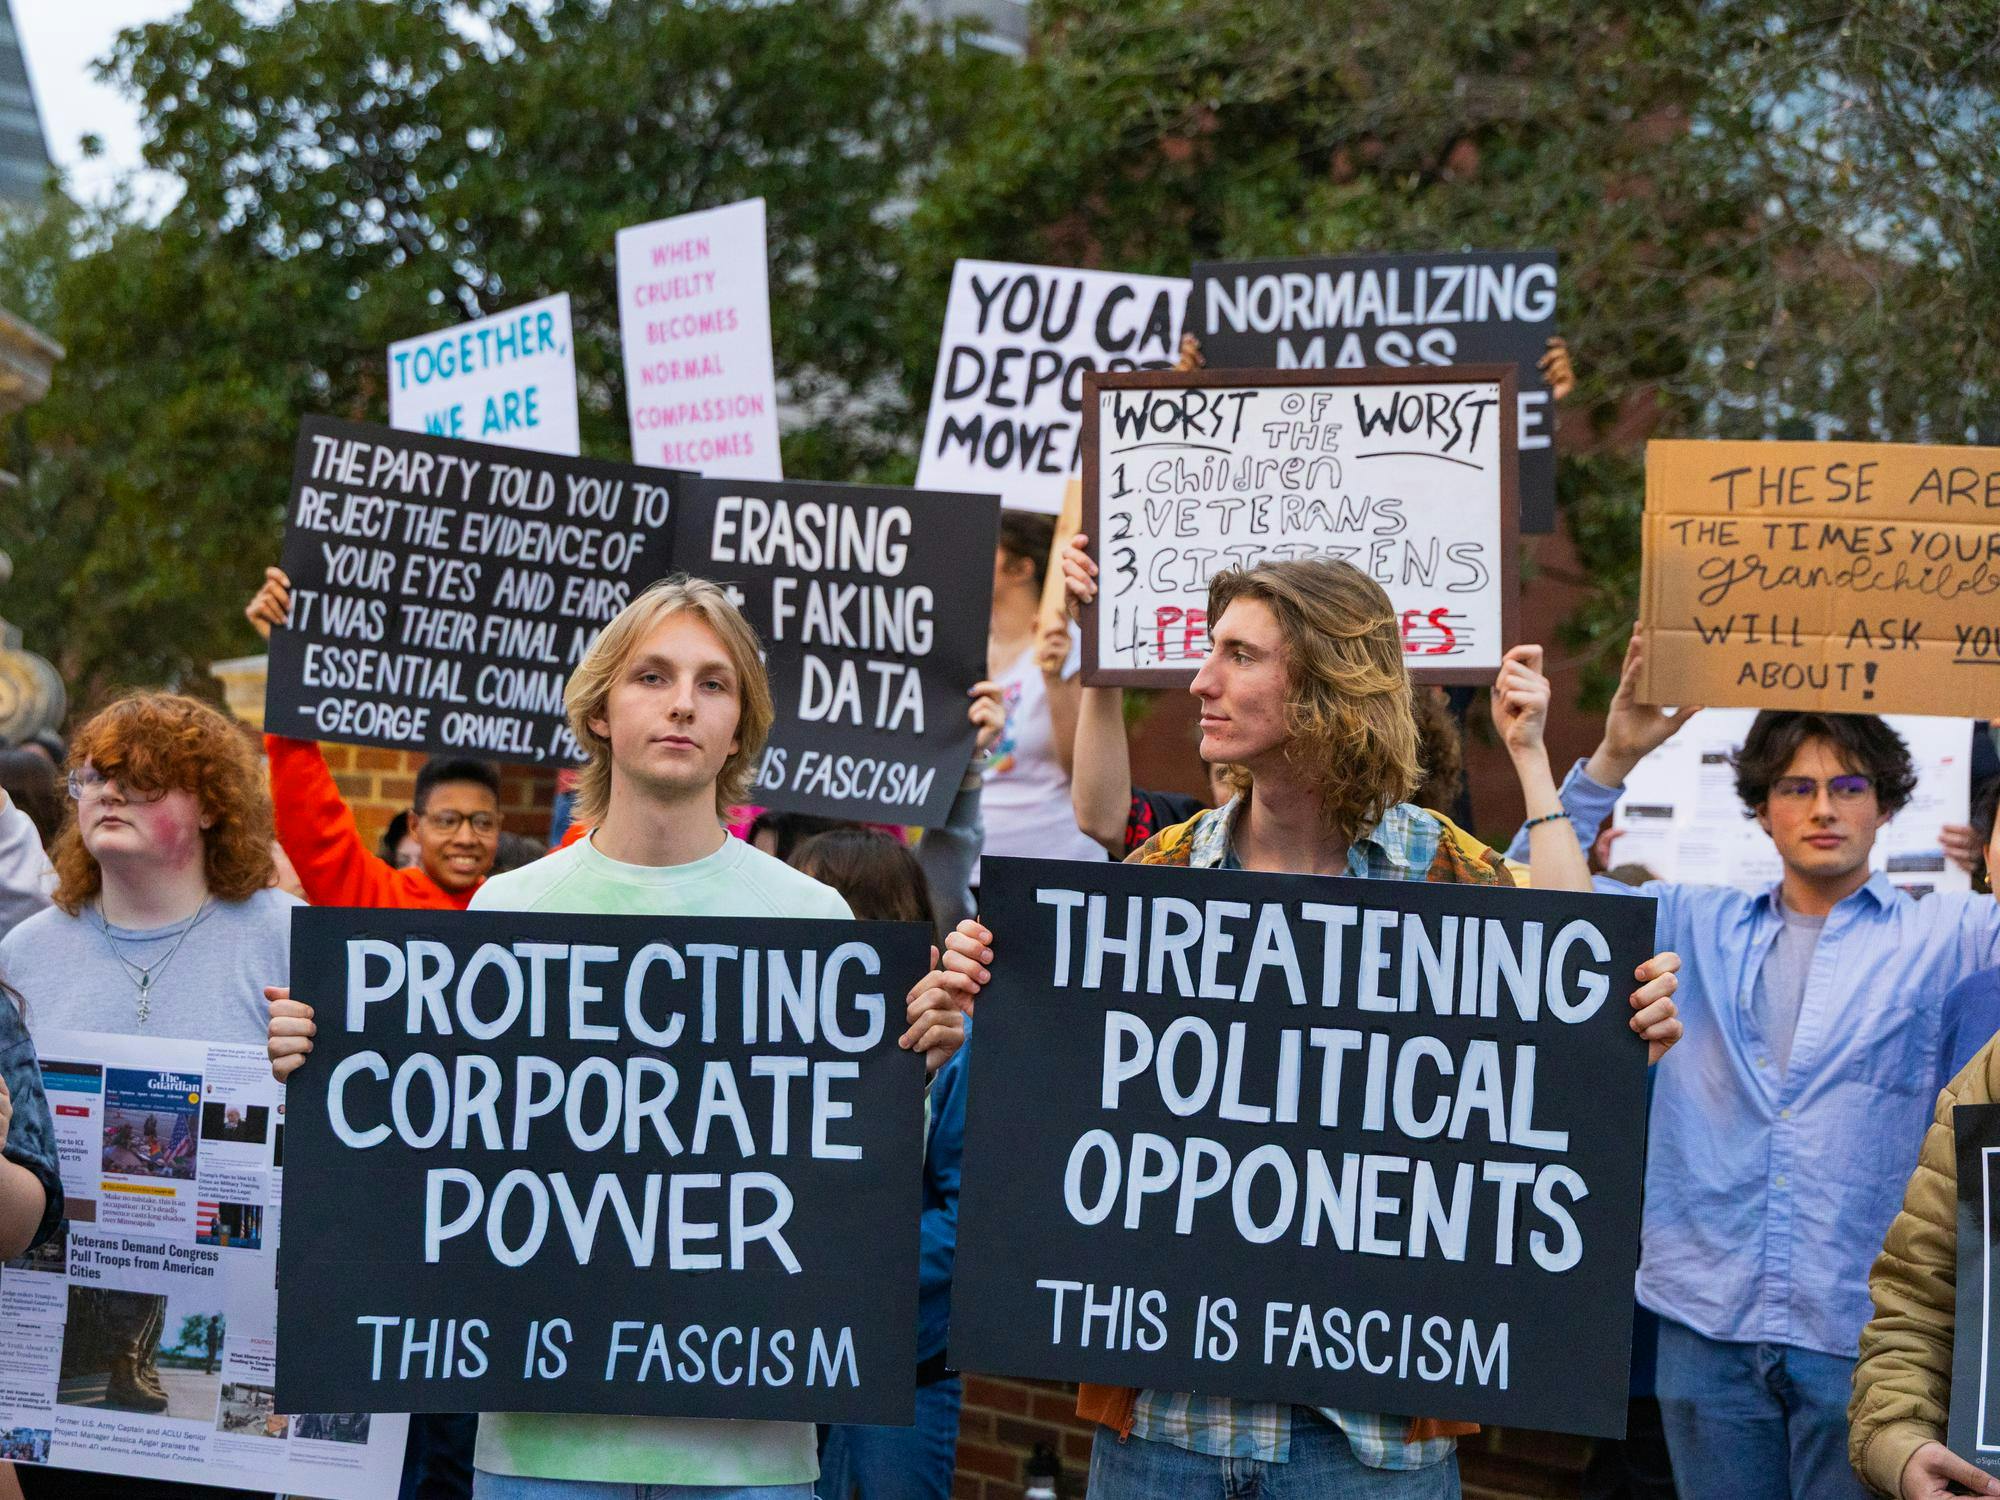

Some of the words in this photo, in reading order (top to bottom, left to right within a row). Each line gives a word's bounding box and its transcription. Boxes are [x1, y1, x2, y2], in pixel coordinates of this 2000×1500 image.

[651, 238, 710, 267] WHEN
[634, 271, 715, 308] CRUELTY
[971, 275, 1083, 343] YOU
[1205, 263, 1557, 335] NORMALIZING
[395, 311, 566, 389] TOGETHER,
[647, 308, 738, 345] BECOMES
[642, 355, 724, 386] NORMAL
[425, 405, 465, 439] WE
[483, 387, 538, 436] ARE
[636, 394, 764, 430] COMPASSION
[1281, 393, 1332, 422] OF
[663, 433, 753, 464] BECOMES
[938, 415, 1081, 473] MOVE
[1263, 421, 1342, 453] THE
[311, 435, 370, 486] THE
[369, 442, 480, 500] PARTY
[487, 463, 555, 511] TOLD
[566, 474, 623, 521] YOU
[633, 483, 669, 528] TO
[1710, 462, 1879, 510] THESE
[1909, 467, 2000, 508] ARE
[295, 486, 401, 538] REJECT
[400, 503, 456, 550] THE
[460, 513, 599, 569] EVIDENCE
[601, 534, 645, 573] OF
[711, 496, 911, 577] ERASING
[1143, 494, 1407, 537] VETERANS
[1670, 519, 1740, 546] THE
[1763, 523, 1896, 555] TIMES
[322, 542, 396, 592] YOUR
[401, 554, 481, 601] EYES
[495, 567, 555, 612] AND
[559, 580, 629, 621] EARS
[286, 589, 318, 632] IT
[321, 595, 386, 642] WAS
[401, 605, 475, 652] THEIR
[480, 615, 558, 663] FINAL
[773, 577, 933, 655] FAKING
[1693, 613, 1805, 647] WILL
[1846, 617, 1922, 650] ASK
[303, 643, 467, 703] ESSENTIAL
[477, 664, 566, 716] COMM
[798, 655, 925, 733] DATA
[1737, 661, 1878, 700] ABOUT!
[440, 712, 546, 761] ORWELL,
[756, 746, 787, 791] IS
[792, 751, 936, 806] FASCISM
[1035, 888, 1611, 1025] THREATENING
[346, 938, 886, 1053] PROTECTING
[147, 1079, 200, 1092] Guardian
[159, 1072, 179, 1083] The
[1101, 1009, 1570, 1152] POLITICAL
[326, 1050, 863, 1160] CORPORATE
[117, 1217, 156, 1228] Minneapolis
[424, 1167, 802, 1275] POWER
[1063, 1128, 1589, 1273] OPPONENTS
[70, 1249, 91, 1263] Pull
[95, 1251, 131, 1269] Troops
[134, 1256, 160, 1271] from
[162, 1259, 214, 1277] American
[70, 1264, 101, 1279] Cities
[71, 1233, 118, 1250] Veterans
[122, 1239, 165, 1256] Demand
[169, 1245, 219, 1262] Congress
[357, 1315, 489, 1381] THIS
[524, 1318, 573, 1380] IS
[605, 1321, 860, 1388] FASCISM
[1037, 1279, 1167, 1351] THIS
[1195, 1295, 1238, 1361] IS
[1265, 1302, 1508, 1390] FASCISM
[54, 1427, 78, 1438] Project
[80, 1431, 109, 1442] Manager
[112, 1435, 136, 1444] Jessica
[188, 1444, 199, 1452] the
[56, 1416, 80, 1425] Former
[97, 1421, 115, 1431] Army
[118, 1423, 144, 1434] Captain
[146, 1428, 160, 1436] and
[161, 1429, 182, 1438] ACLU
[184, 1431, 206, 1441] Senior
